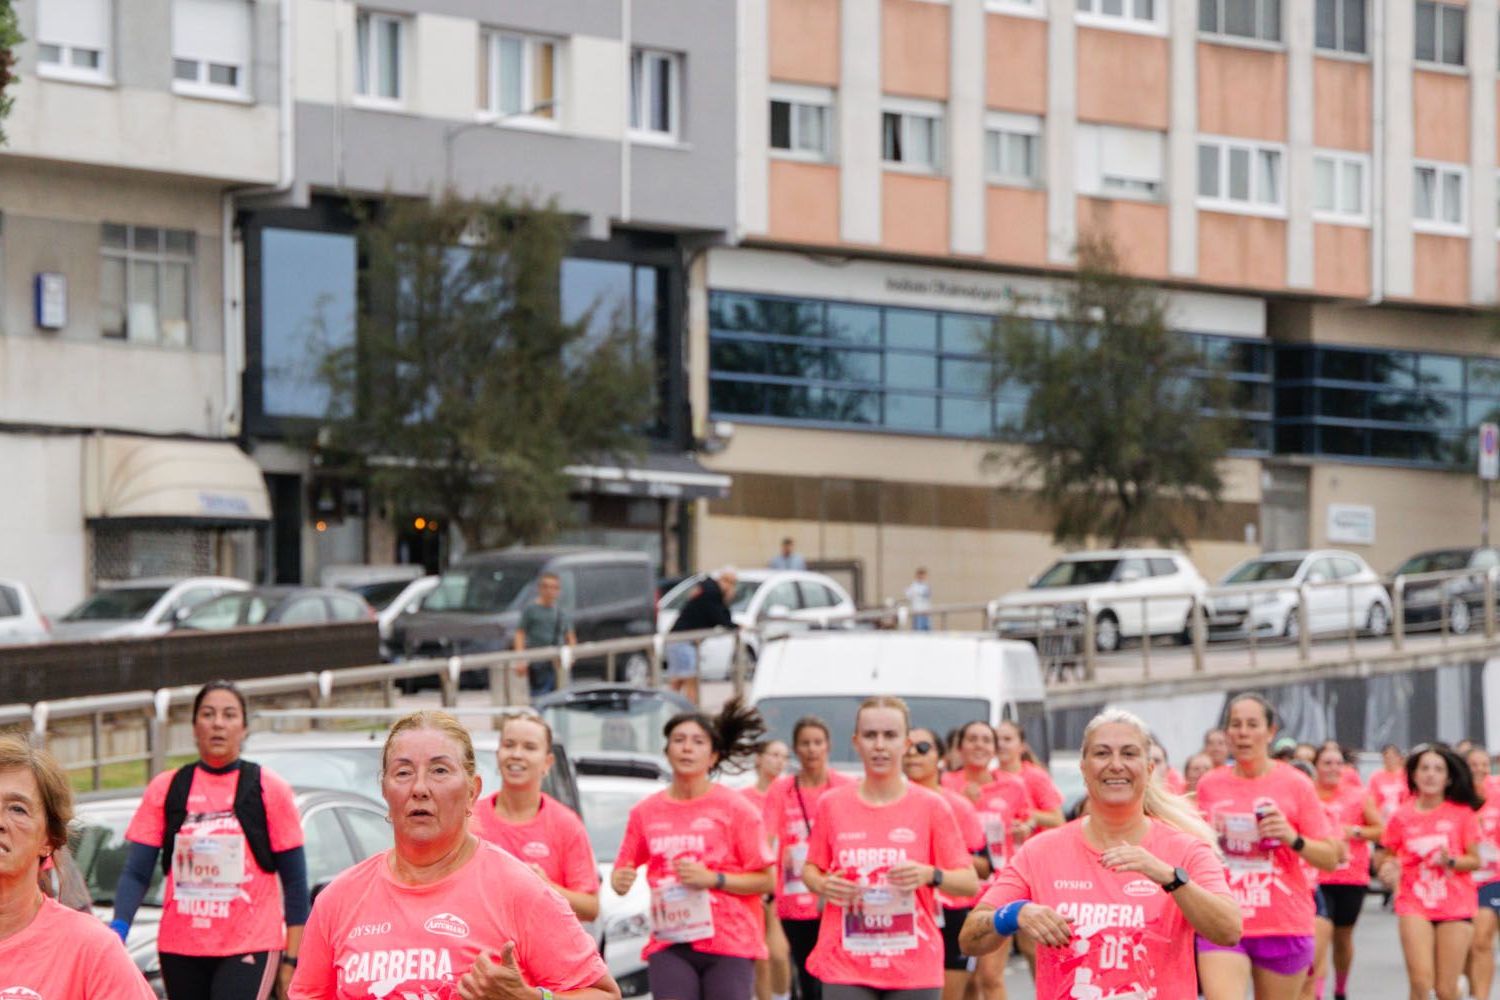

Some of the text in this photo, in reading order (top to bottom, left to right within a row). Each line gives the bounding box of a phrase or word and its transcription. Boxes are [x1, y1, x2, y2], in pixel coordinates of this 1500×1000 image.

[194, 865, 220, 876] 016
[1054, 880, 1093, 890] OYSHO
[1056, 902, 1146, 928] CARRERA
[348, 922, 391, 939] OYSHO
[428, 920, 466, 933] ASTURIANA
[344, 948, 454, 983] CARRERA
